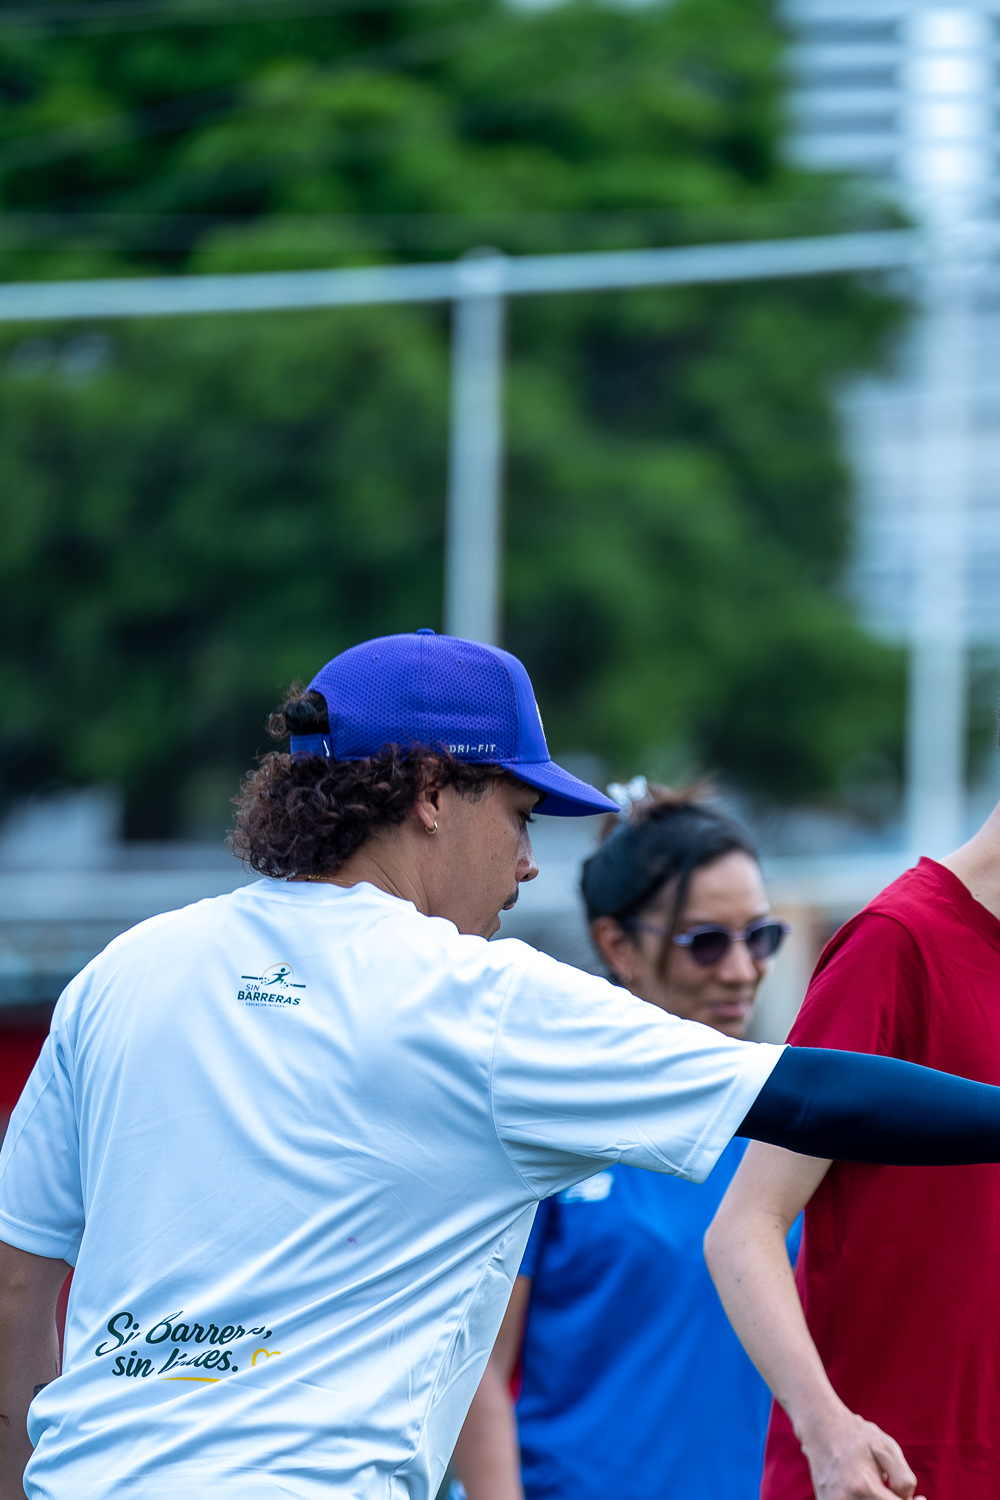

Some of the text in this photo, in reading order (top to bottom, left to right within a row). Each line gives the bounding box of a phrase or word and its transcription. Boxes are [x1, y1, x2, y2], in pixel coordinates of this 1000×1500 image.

[448, 743, 497, 754] DRI-FIT
[245, 983, 260, 991] SIN
[237, 990, 302, 1006] BARRERAS
[112, 1350, 155, 1378] sin
